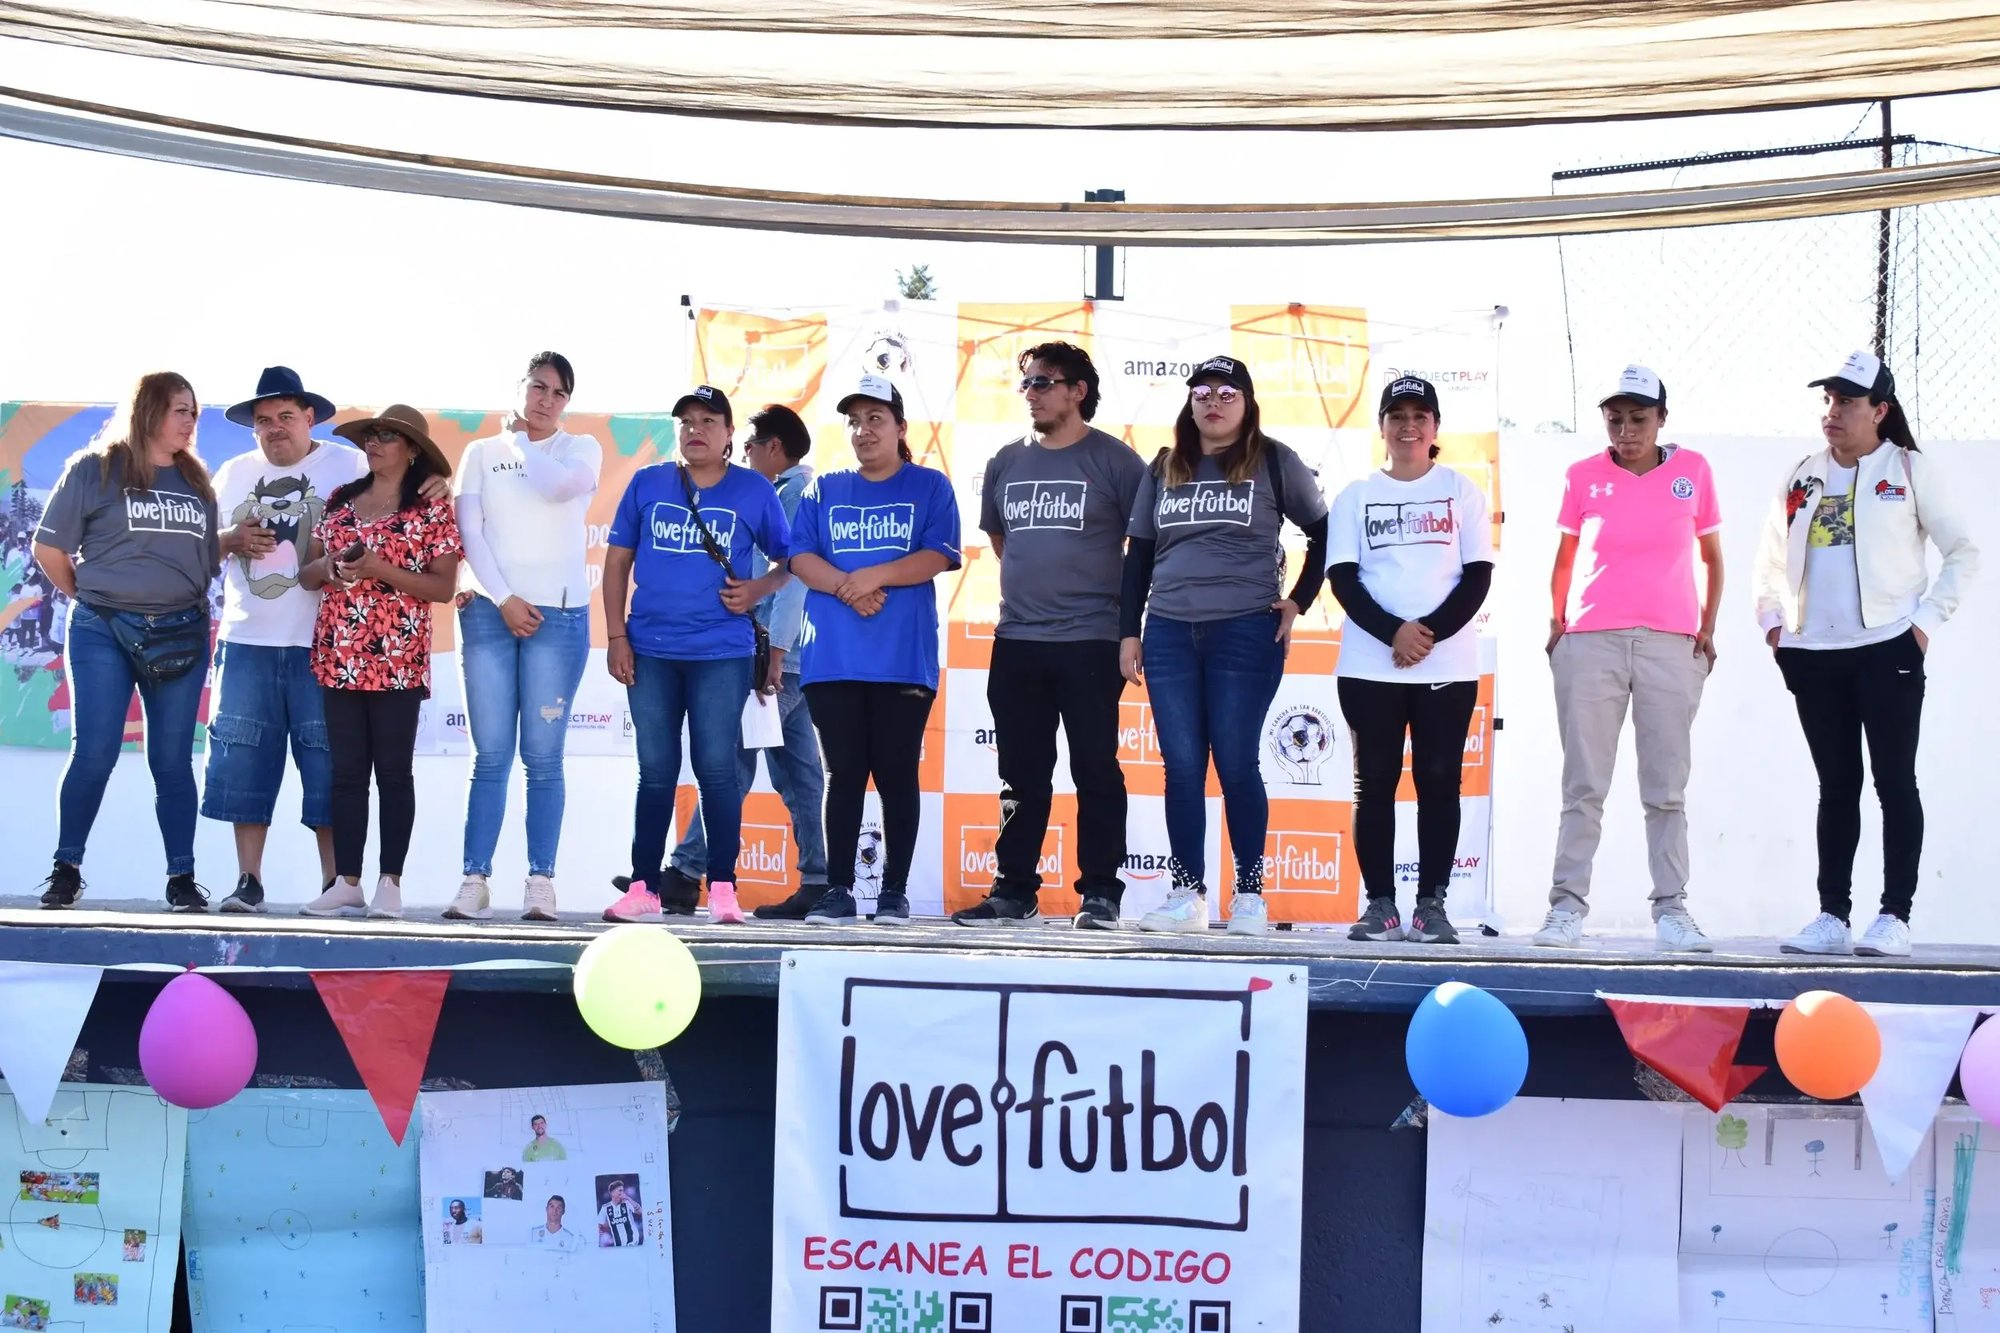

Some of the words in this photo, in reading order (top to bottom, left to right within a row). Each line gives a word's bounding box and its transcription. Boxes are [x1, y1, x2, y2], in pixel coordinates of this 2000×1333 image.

[493, 462, 523, 473] CALI
[126, 495, 161, 520] love
[1004, 493, 1030, 520] love
[1159, 491, 1190, 516] love
[829, 515, 859, 541] love
[1365, 515, 1397, 538] love
[1118, 727, 1140, 750] ve
[838, 1035, 984, 1167] love
[1015, 1040, 1251, 1176] fútbol
[803, 1236, 988, 1277] ESCANEA
[1006, 1243, 1052, 1279] EL
[1069, 1247, 1232, 1285] CODIGO
